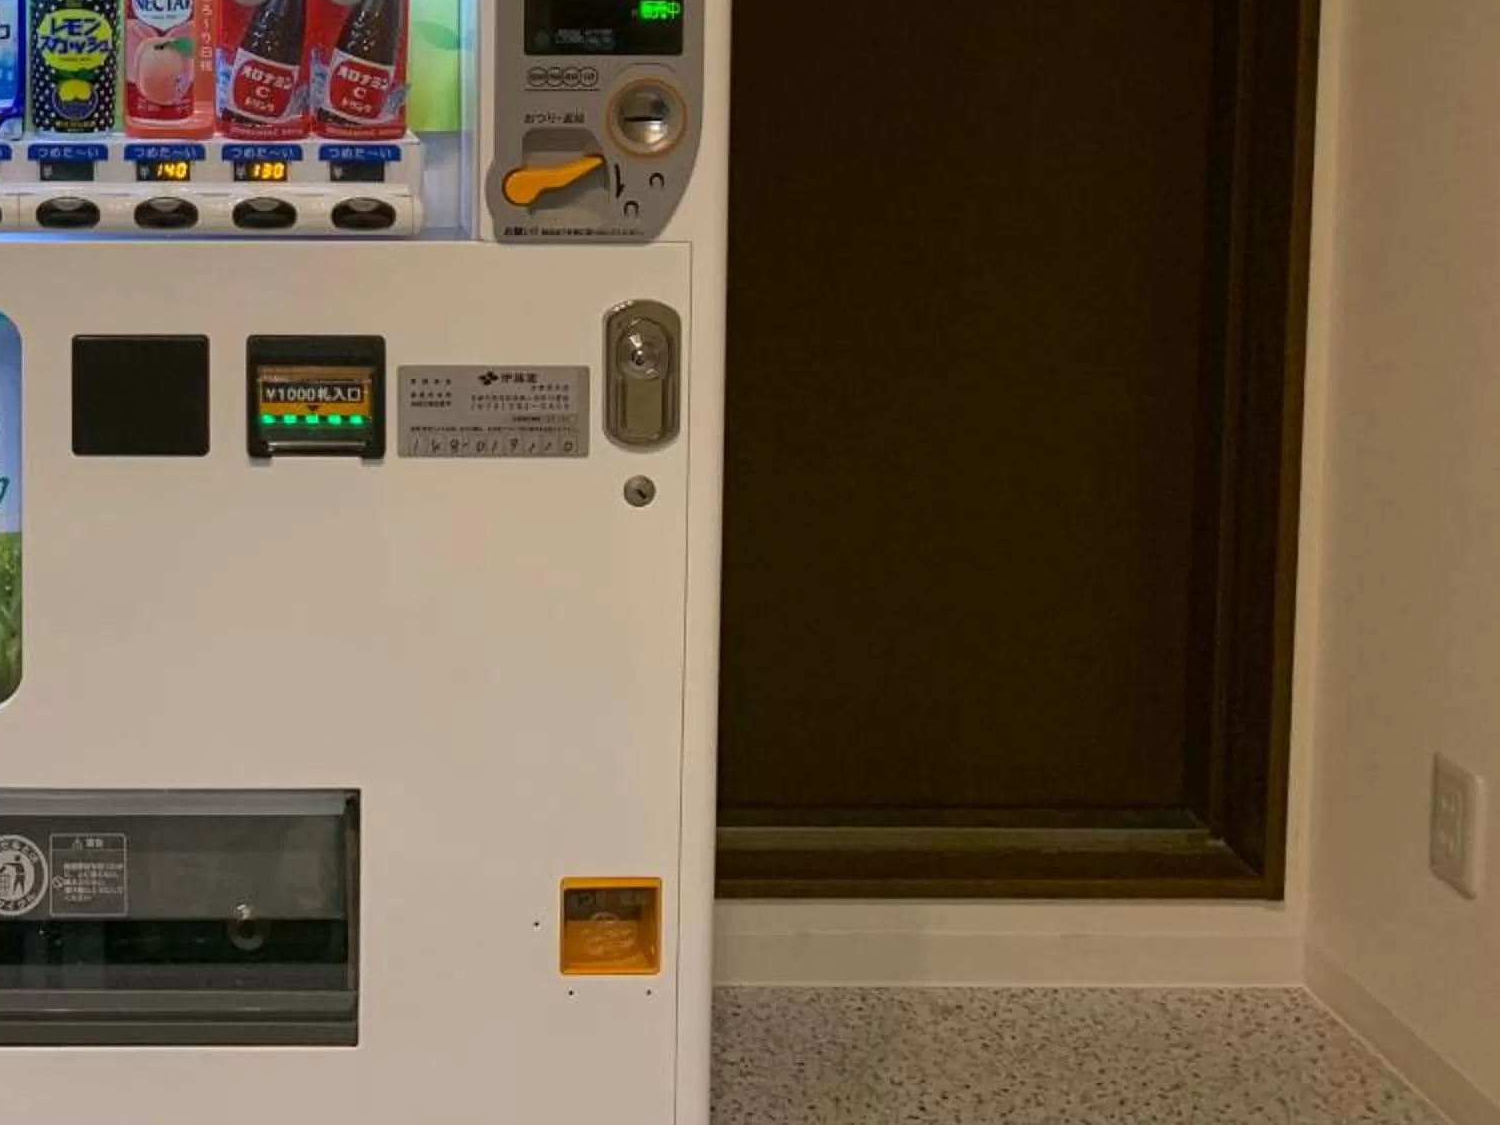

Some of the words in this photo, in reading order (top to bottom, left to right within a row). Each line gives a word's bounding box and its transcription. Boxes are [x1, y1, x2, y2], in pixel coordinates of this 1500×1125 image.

[51, 17, 102, 36] レモン
[40, 35, 110, 55] スカッシュ
[241, 65, 293, 91] オロナミン
[337, 65, 389, 91] オロナミン
[255, 85, 269, 99] C
[352, 86, 367, 99] C
[245, 96, 275, 113] ドリンク
[340, 96, 373, 114] ドリンク
[157, 161, 187, 179] 140
